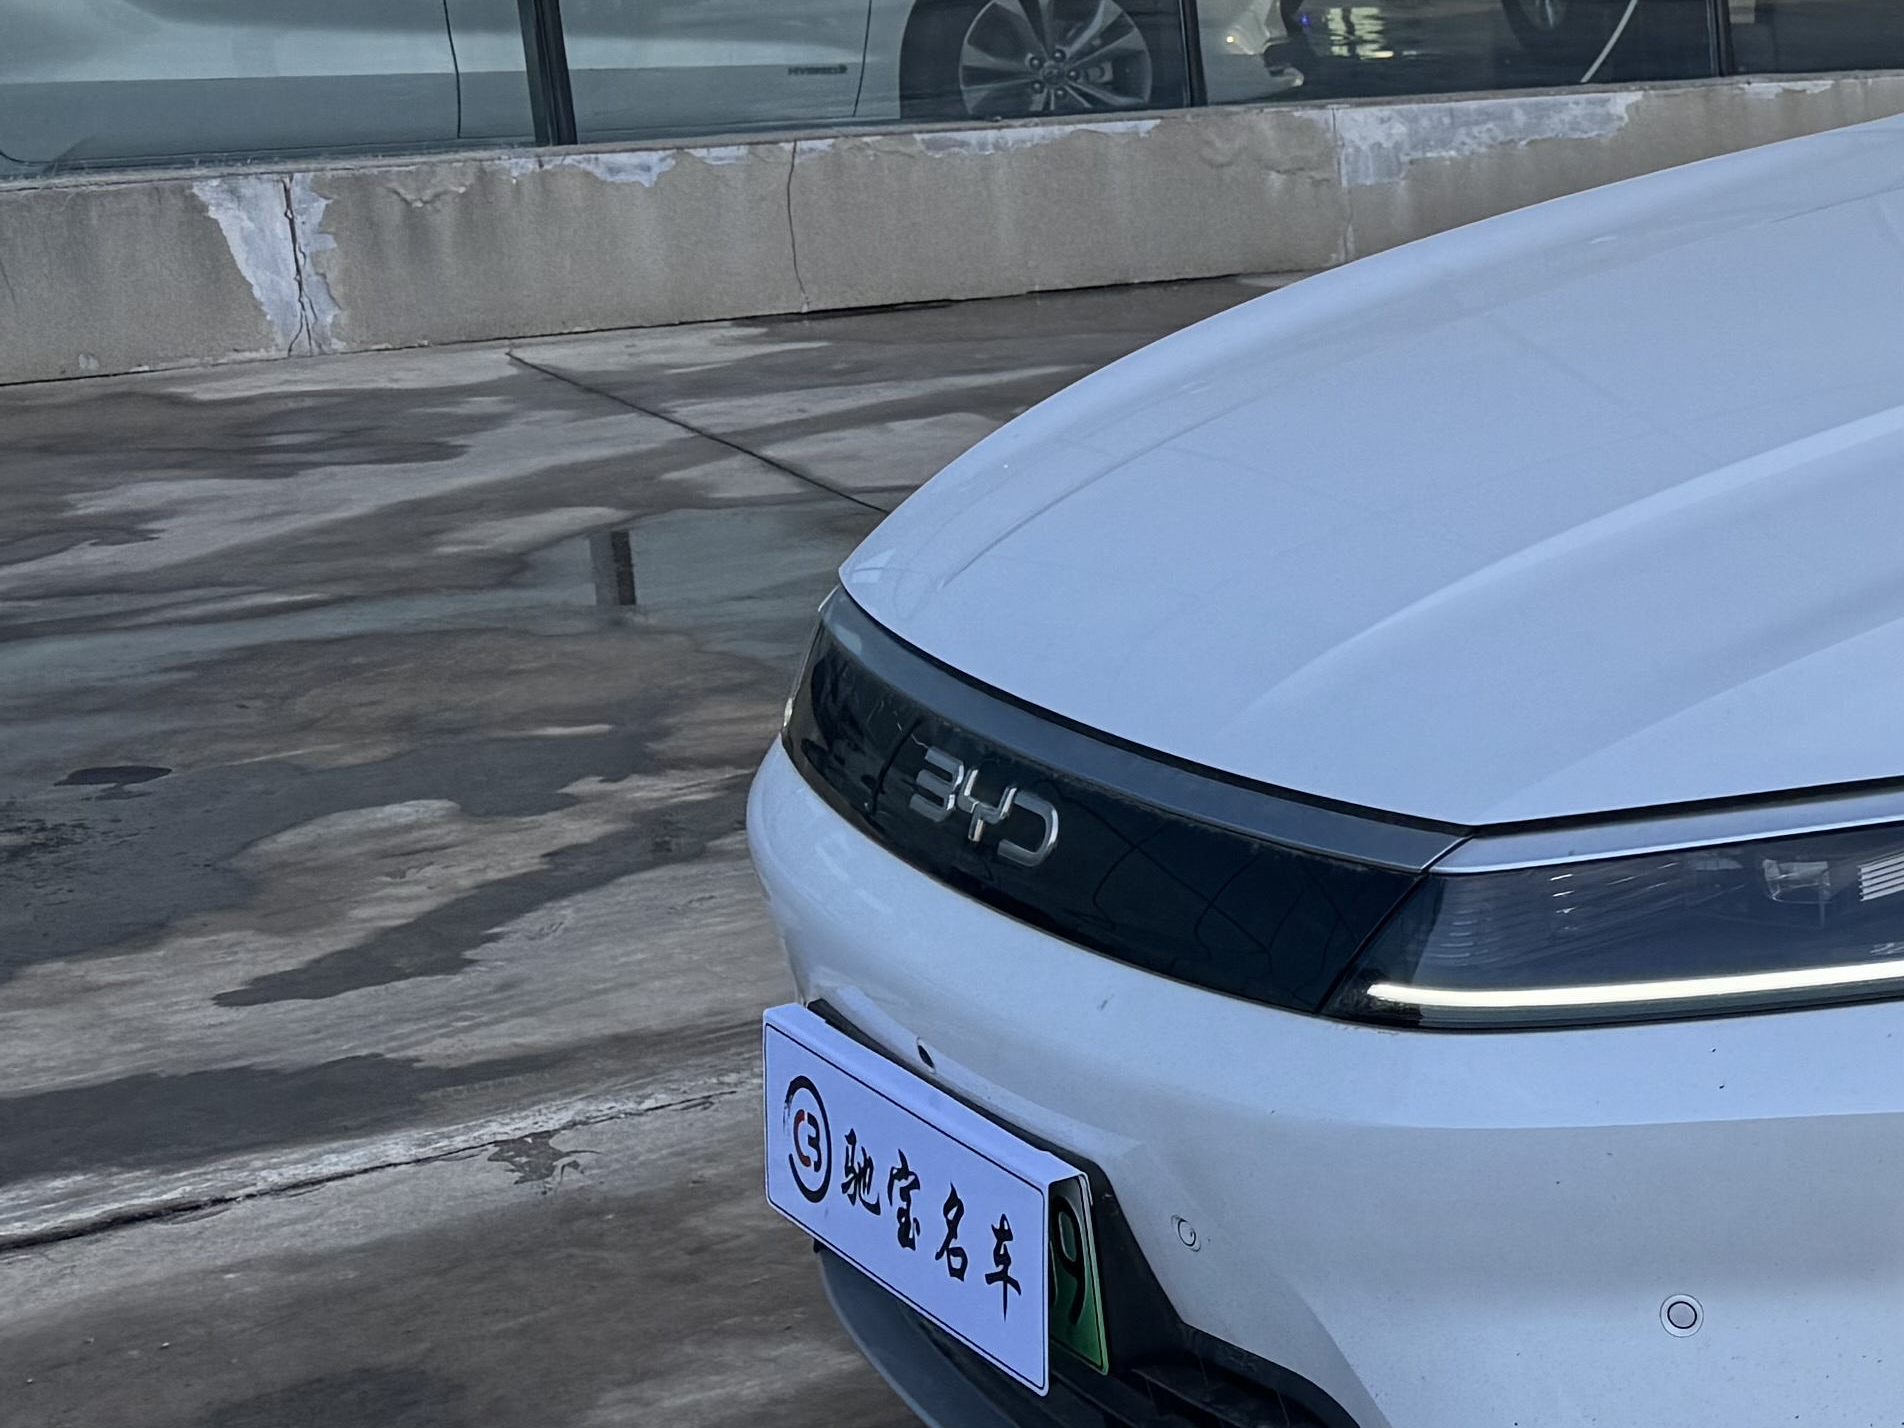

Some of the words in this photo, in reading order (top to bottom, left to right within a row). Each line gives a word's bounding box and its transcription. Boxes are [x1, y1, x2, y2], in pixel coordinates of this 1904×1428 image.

[909, 746, 1060, 868] BYD
[841, 1128, 1022, 1322] 驰宝名车
